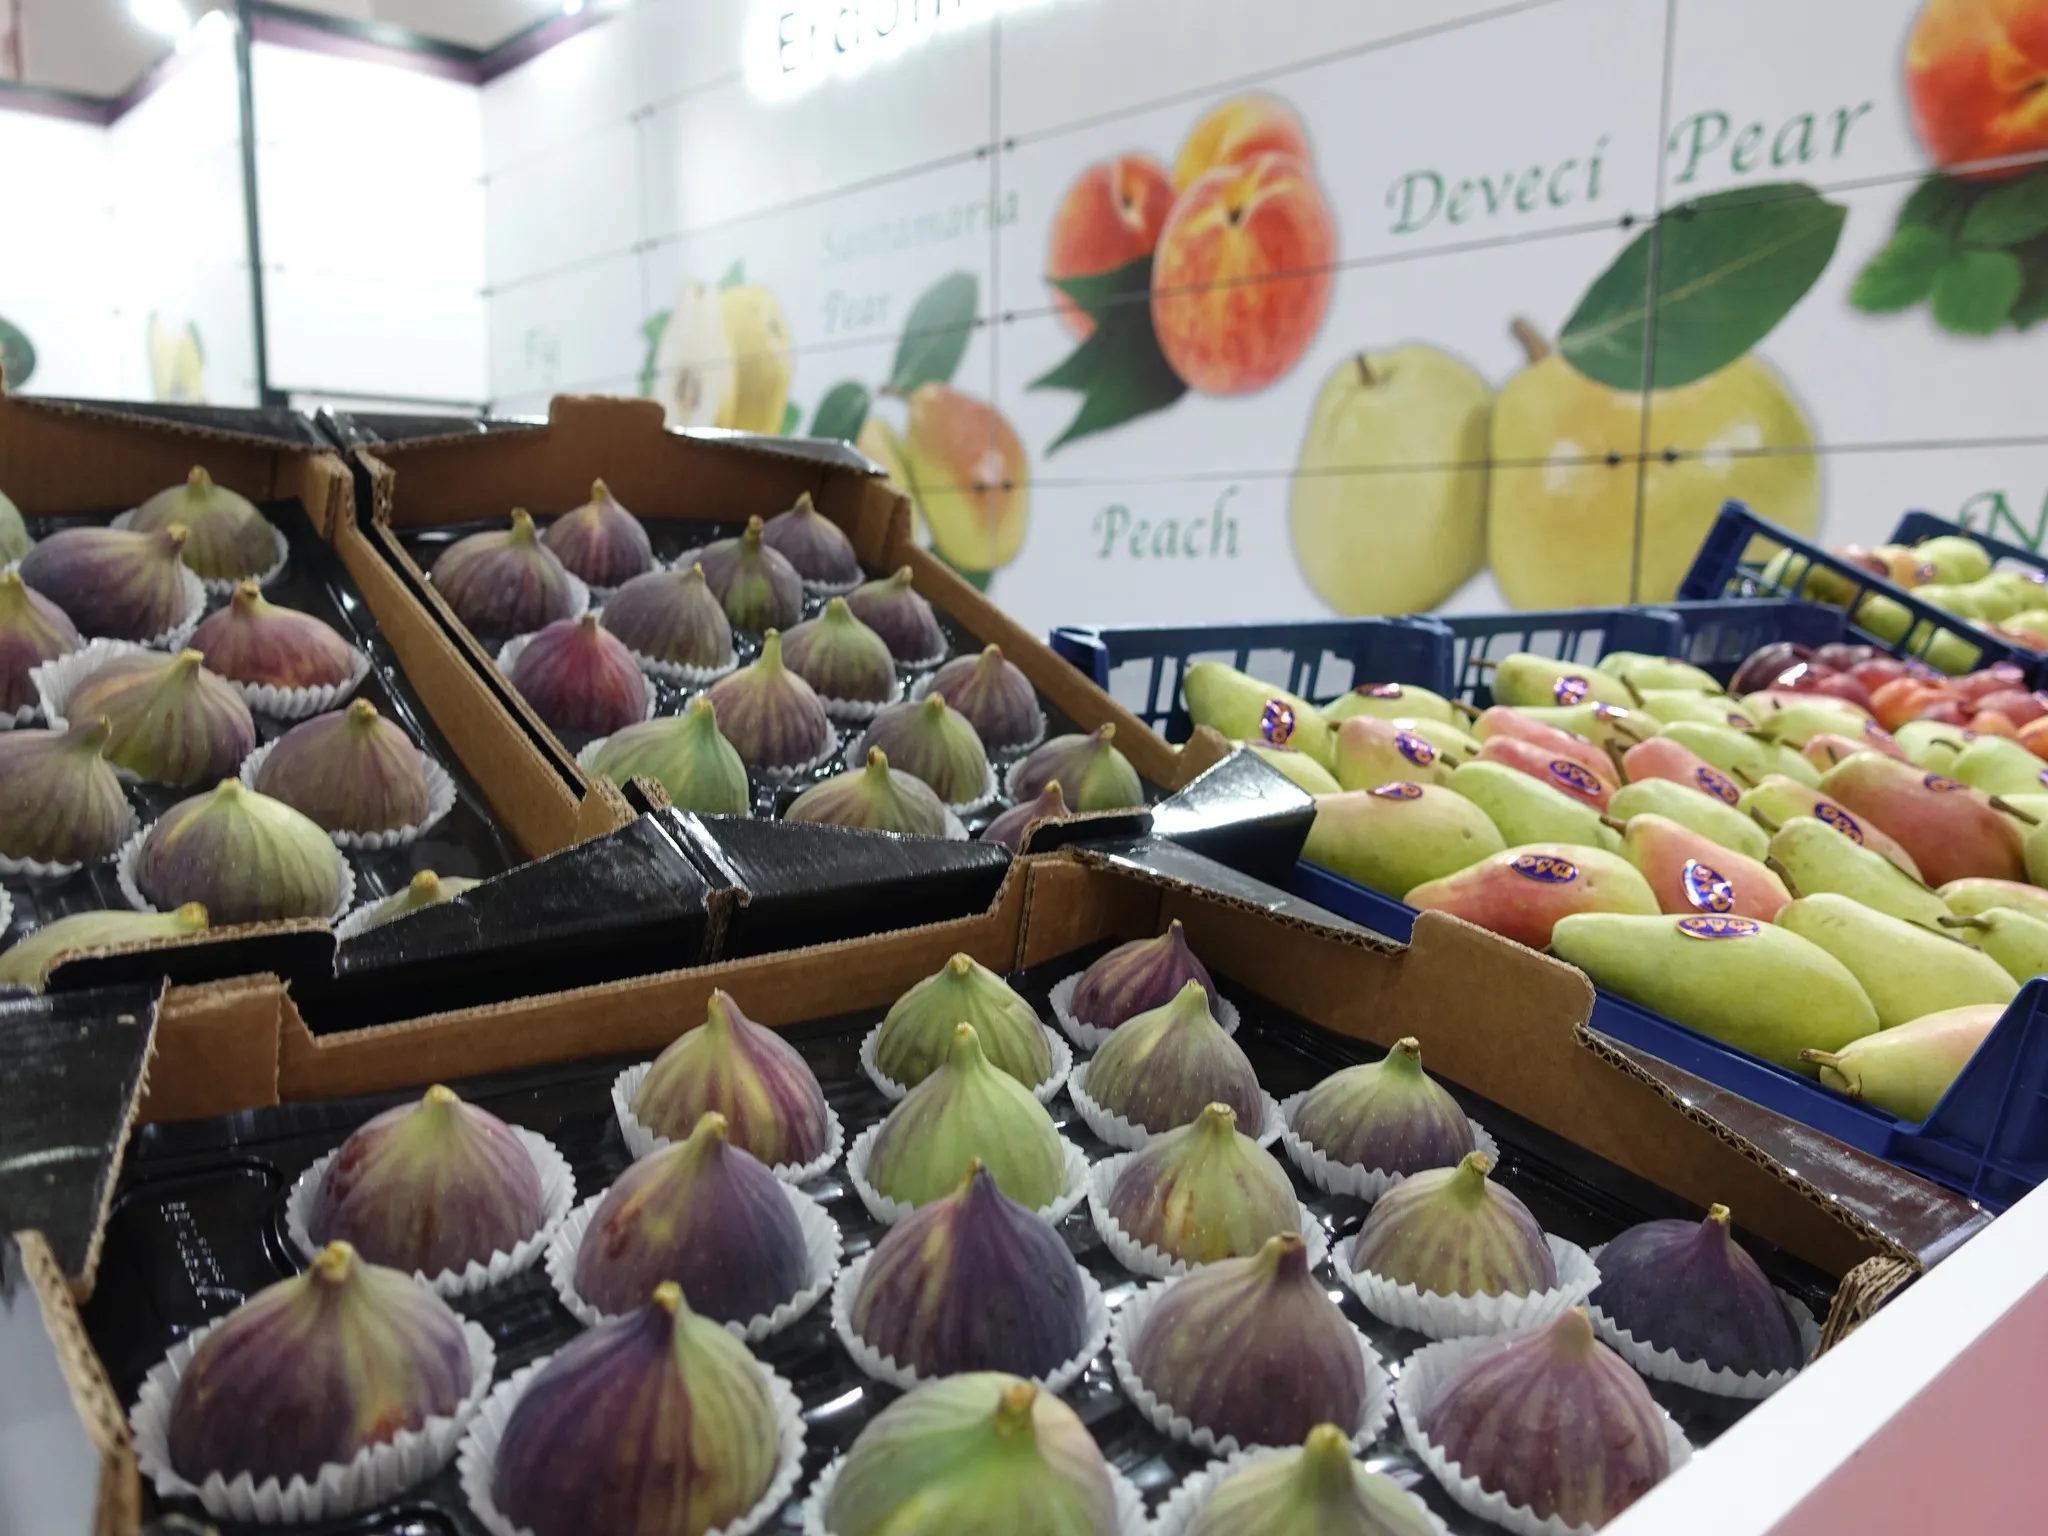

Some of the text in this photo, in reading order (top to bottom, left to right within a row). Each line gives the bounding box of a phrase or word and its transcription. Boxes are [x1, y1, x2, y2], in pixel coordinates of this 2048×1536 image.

[1385, 100, 1875, 234] Deveci Pear
[1091, 484, 1242, 560] Peach
